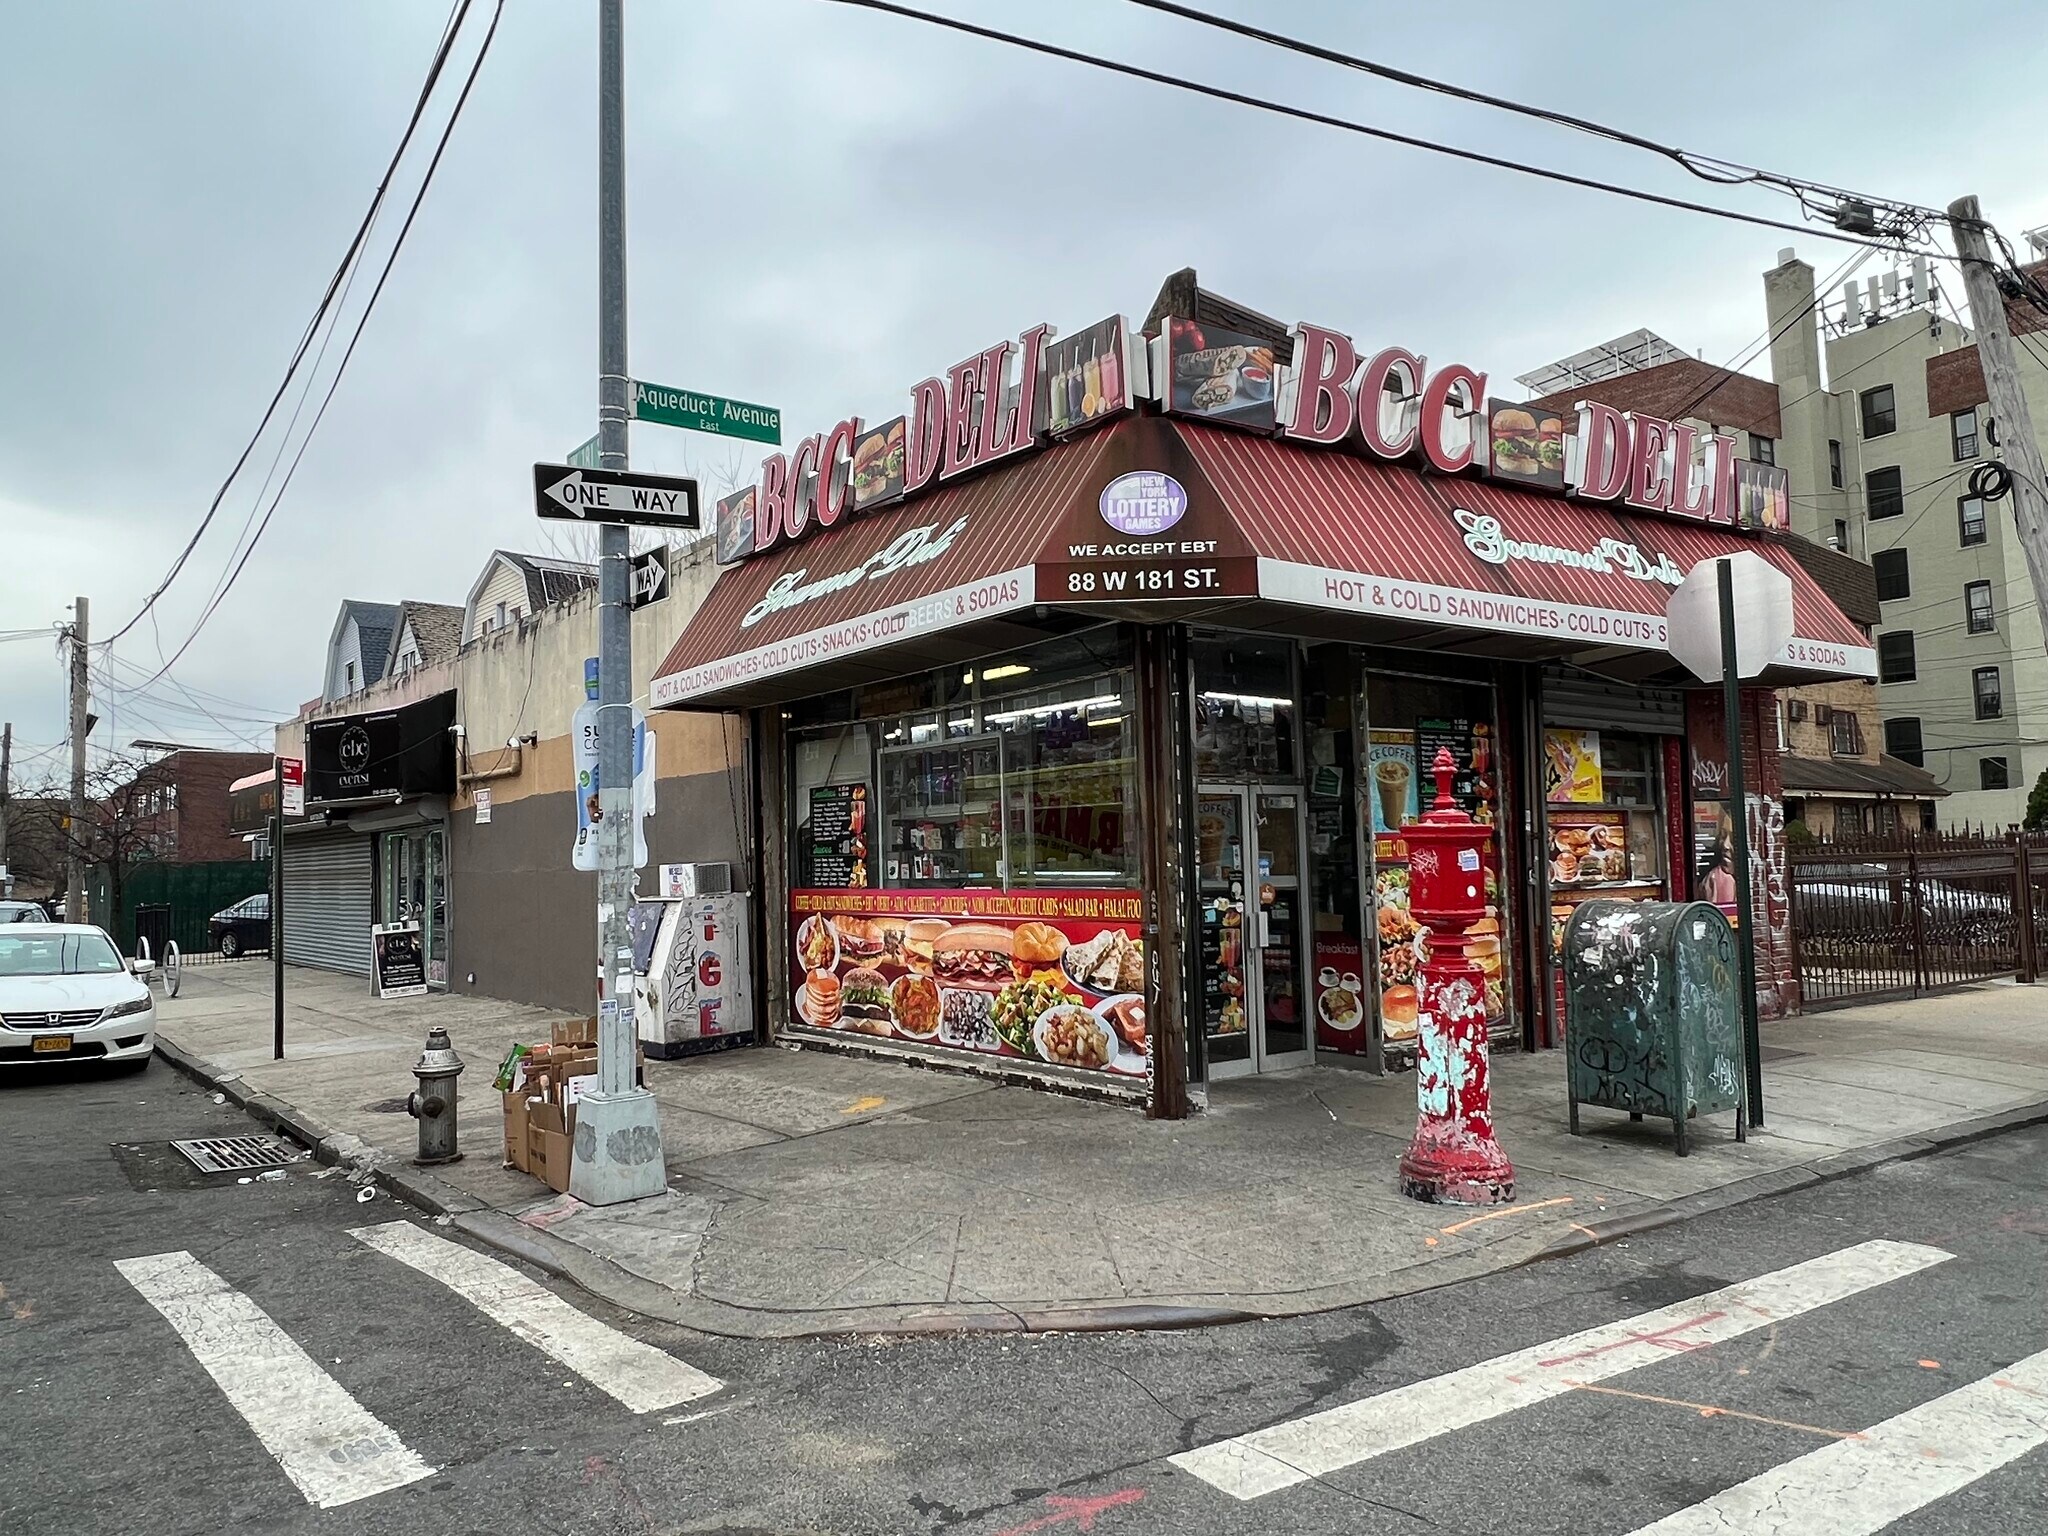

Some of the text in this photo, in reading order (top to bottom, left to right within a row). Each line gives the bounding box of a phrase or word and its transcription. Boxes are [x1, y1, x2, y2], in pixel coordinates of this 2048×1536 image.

[636, 384, 779, 428] Aqueduct Avenue
[1285, 321, 1489, 472] BCC
[903, 322, 1055, 494] DELI
[700, 419, 720, 432] East
[1574, 399, 1737, 525] DELI
[755, 416, 861, 552] BCC
[1141, 476, 1165, 487] NEW
[1141, 487, 1168, 498] YORK
[562, 483, 679, 512] ONE WAY
[1107, 497, 1180, 518] LOTTERY
[1124, 518, 1162, 530] GAMES
[1068, 541, 1217, 556] WE ACCEPT EBT
[636, 567, 659, 591] WAY
[1068, 568, 1220, 592] 88 W 181 ST.
[1324, 577, 1366, 603] HOT
[1372, 585, 1385, 606] &
[1391, 588, 1441, 614] COLD
[1447, 597, 1559, 629] SANDWICHES
[1568, 613, 1609, 635] COLD
[1613, 619, 1650, 640] CUTS
[656, 682, 672, 699] HOT
[673, 681, 680, 694] &
[680, 673, 702, 693] COLD
[703, 659, 759, 688] SANDWICHES
[762, 648, 790, 671] COLD
[790, 641, 818, 665] CUTS
[822, 627, 867, 653] SNACKS
[909, 598, 952, 630] BEERS
[955, 595, 965, 615] &
[969, 579, 1020, 613] SODAS
[1798, 646, 1807, 661] &
[1809, 646, 1847, 667] SODAS
[1382, 746, 1416, 766] COFFEE
[1104, 899, 1126, 918] HALAL
[1316, 941, 1358, 955] Breakfast
